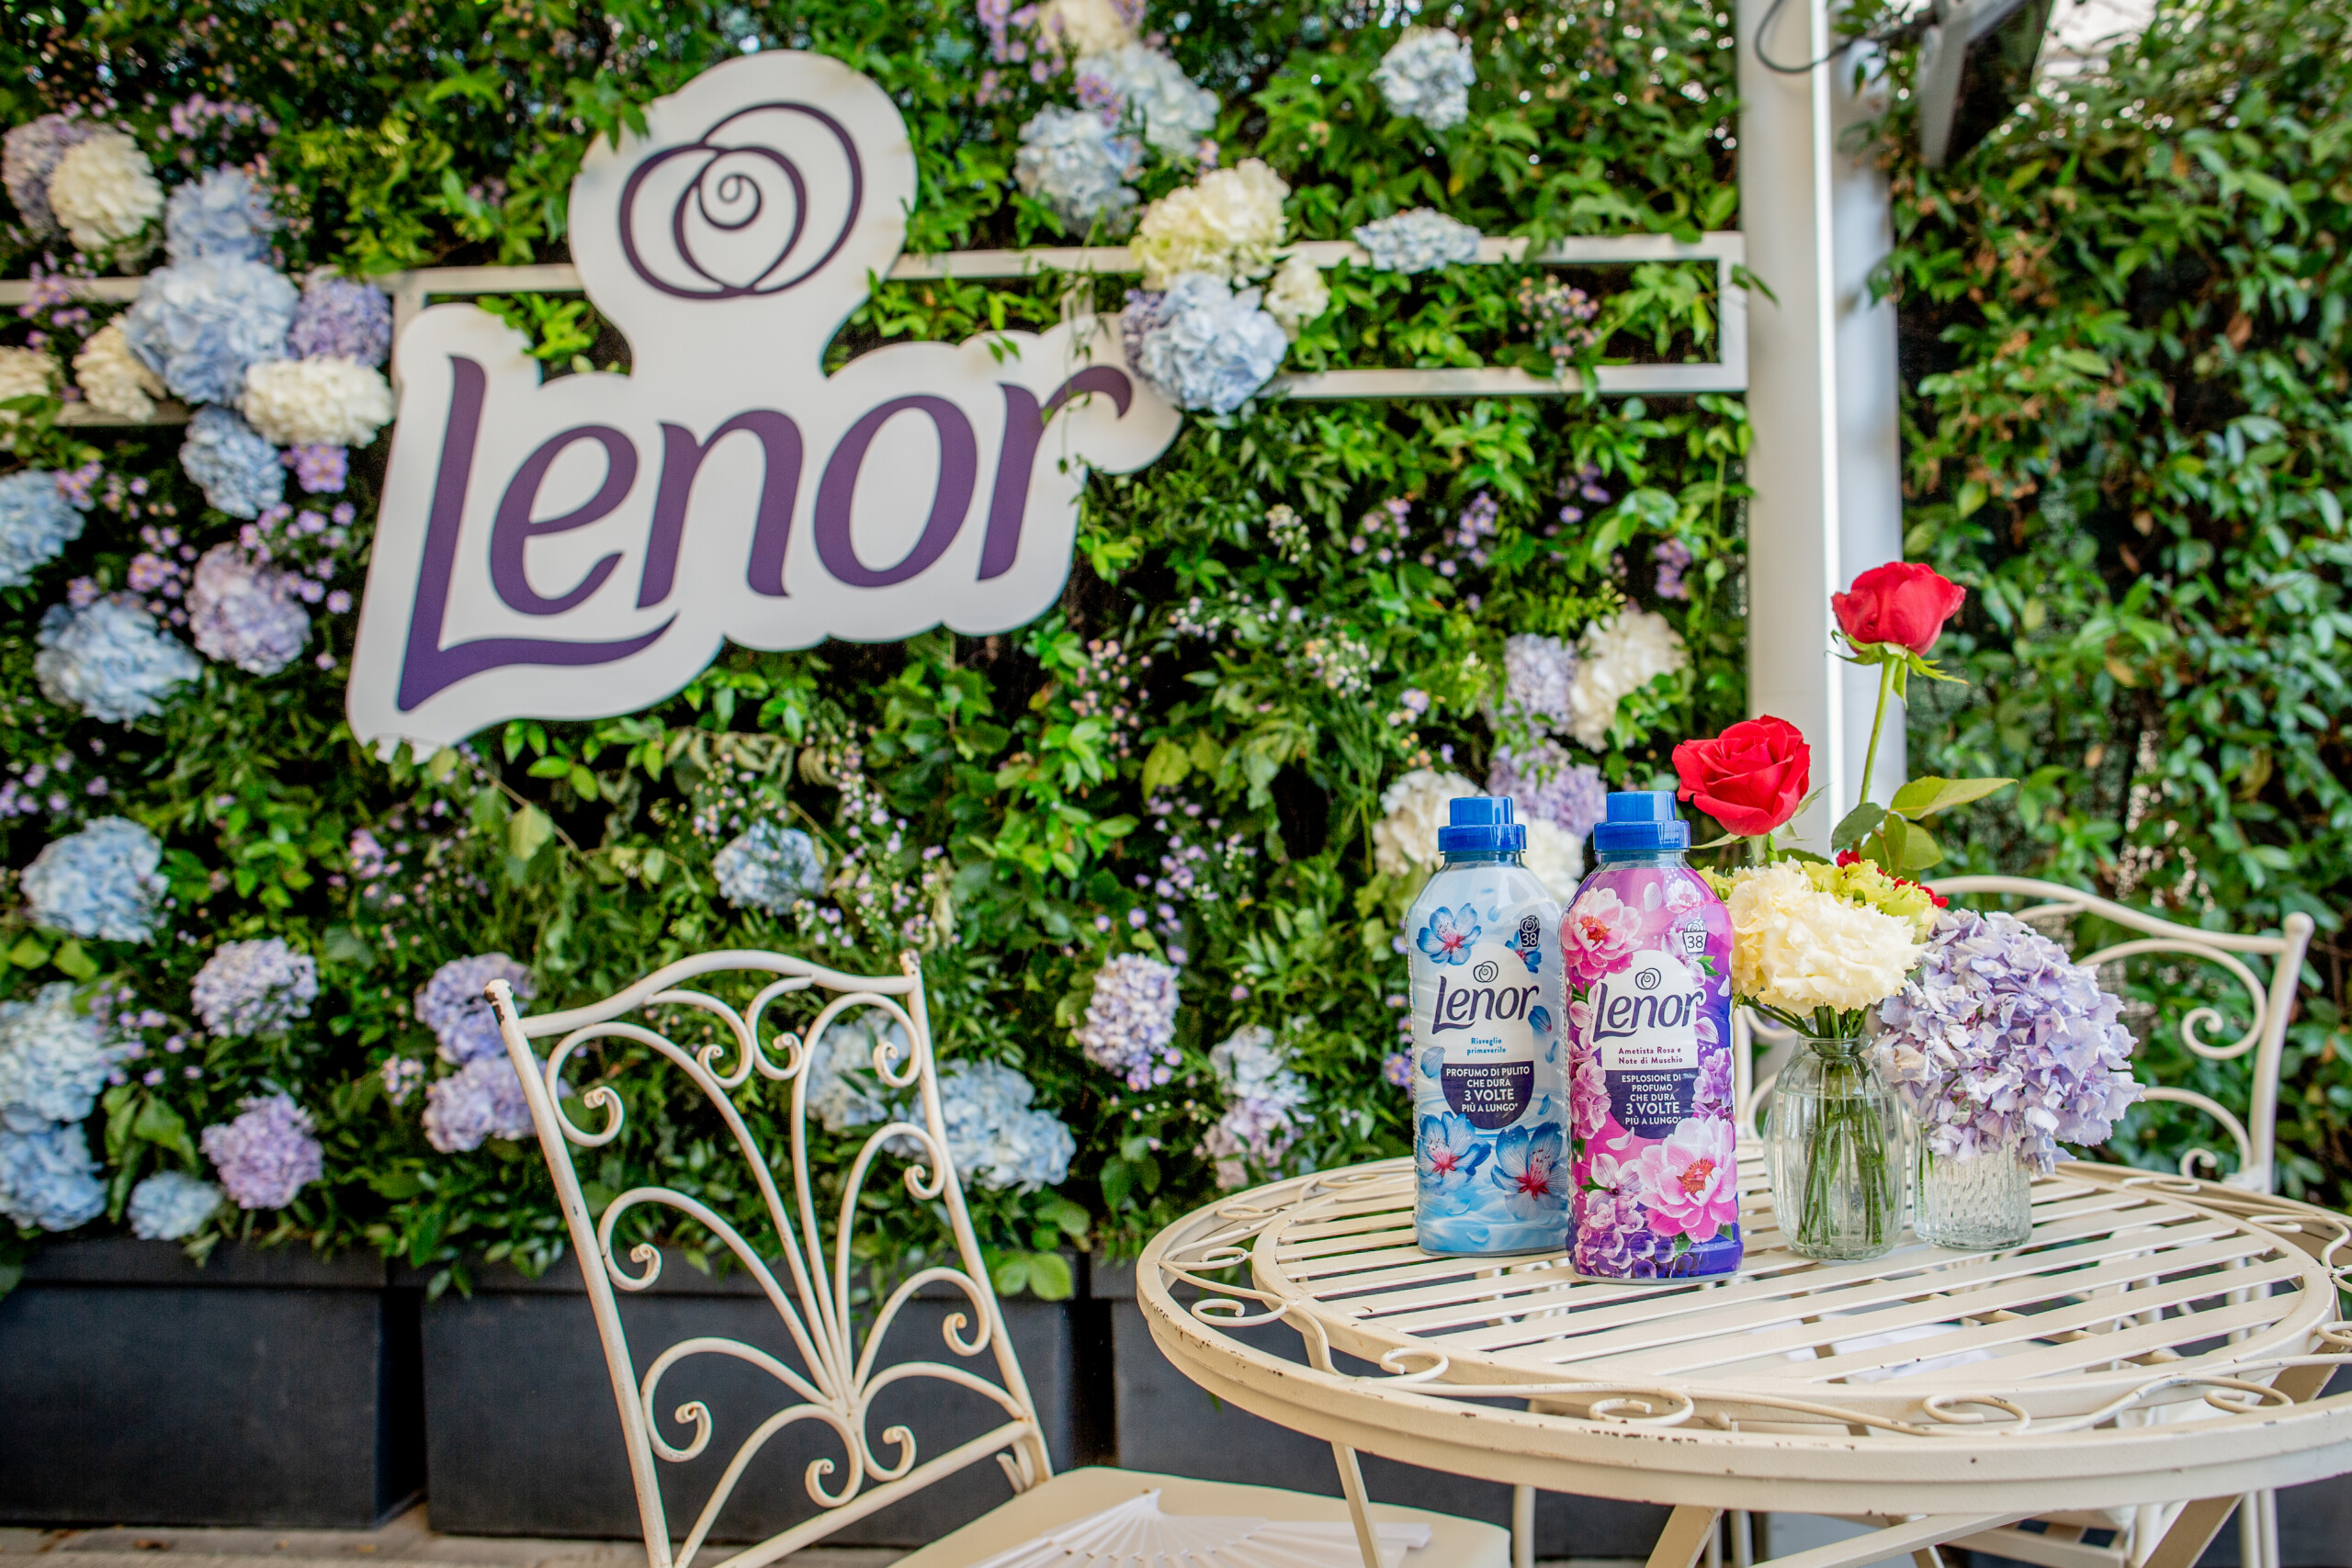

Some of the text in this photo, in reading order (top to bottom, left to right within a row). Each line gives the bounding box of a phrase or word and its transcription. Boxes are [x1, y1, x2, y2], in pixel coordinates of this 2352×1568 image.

[397, 355, 1133, 712] Lenor
[1522, 933, 1536, 946] 38
[1688, 936, 1703, 949] 38
[1432, 976, 1539, 1034] Lenor
[1593, 983, 1704, 1043] Lenor
[1471, 1038, 1502, 1046] Risveglio
[1467, 1046, 1506, 1056] primaverile
[1446, 1066, 1530, 1077] PROFUMO DI PULITO
[1467, 1078, 1510, 1088] CHE DURA
[1622, 1074, 1671, 1082] ESPLOSIONE
[1632, 1084, 1673, 1092] PROFUMO
[1464, 1089, 1514, 1100] 3 VOLTE
[1651, 1093, 1676, 1101] DURA
[1462, 1102, 1476, 1112] PIÙ
[1626, 1102, 1680, 1114] 3 VOLTE
[1624, 1116, 1639, 1125] PIÙ
